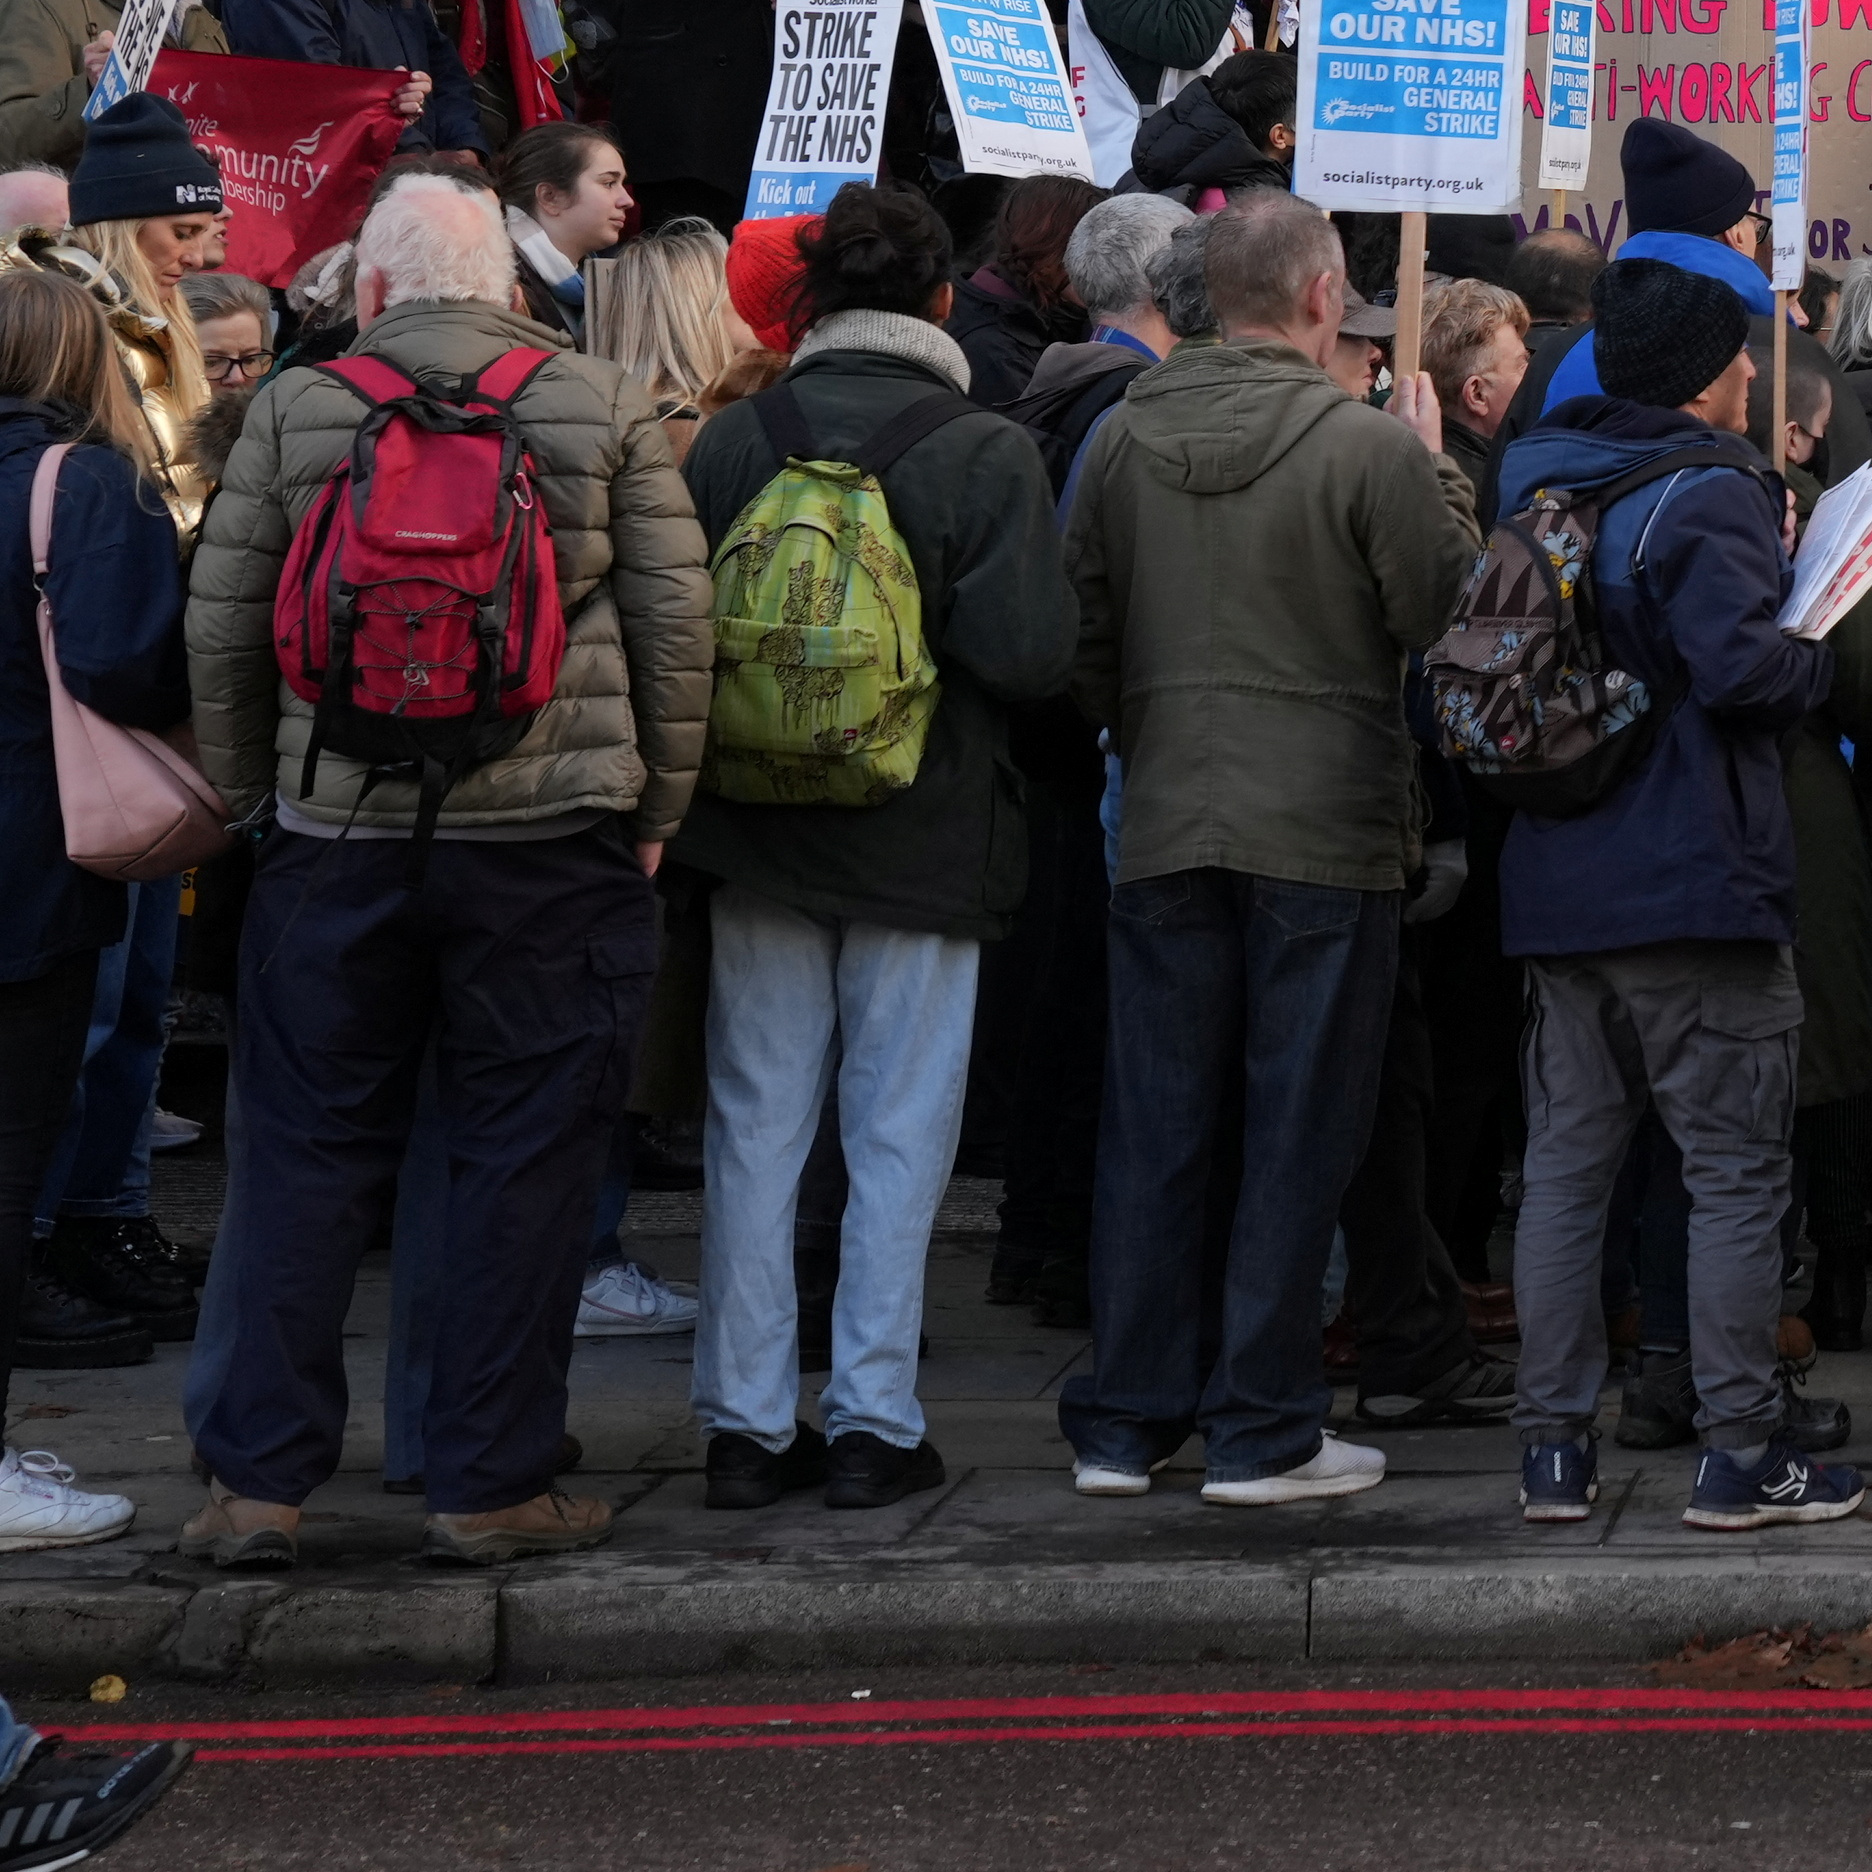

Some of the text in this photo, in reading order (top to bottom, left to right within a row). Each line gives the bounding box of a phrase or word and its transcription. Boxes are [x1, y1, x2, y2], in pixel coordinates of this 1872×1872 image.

[782, 10, 877, 59] STRIKE
[1330, 12, 1496, 47] OUR NHS!
[777, 63, 881, 111] TO SAVE
[1329, 61, 1500, 88] BUILD FOR A 24HR
[1403, 87, 1497, 112] GENERAL
[184, 114, 218, 137] nite
[1424, 112, 1497, 136] STRIKE
[766, 115, 875, 163] THE NHS
[1323, 171, 1483, 194] socialistparty.org.uk
